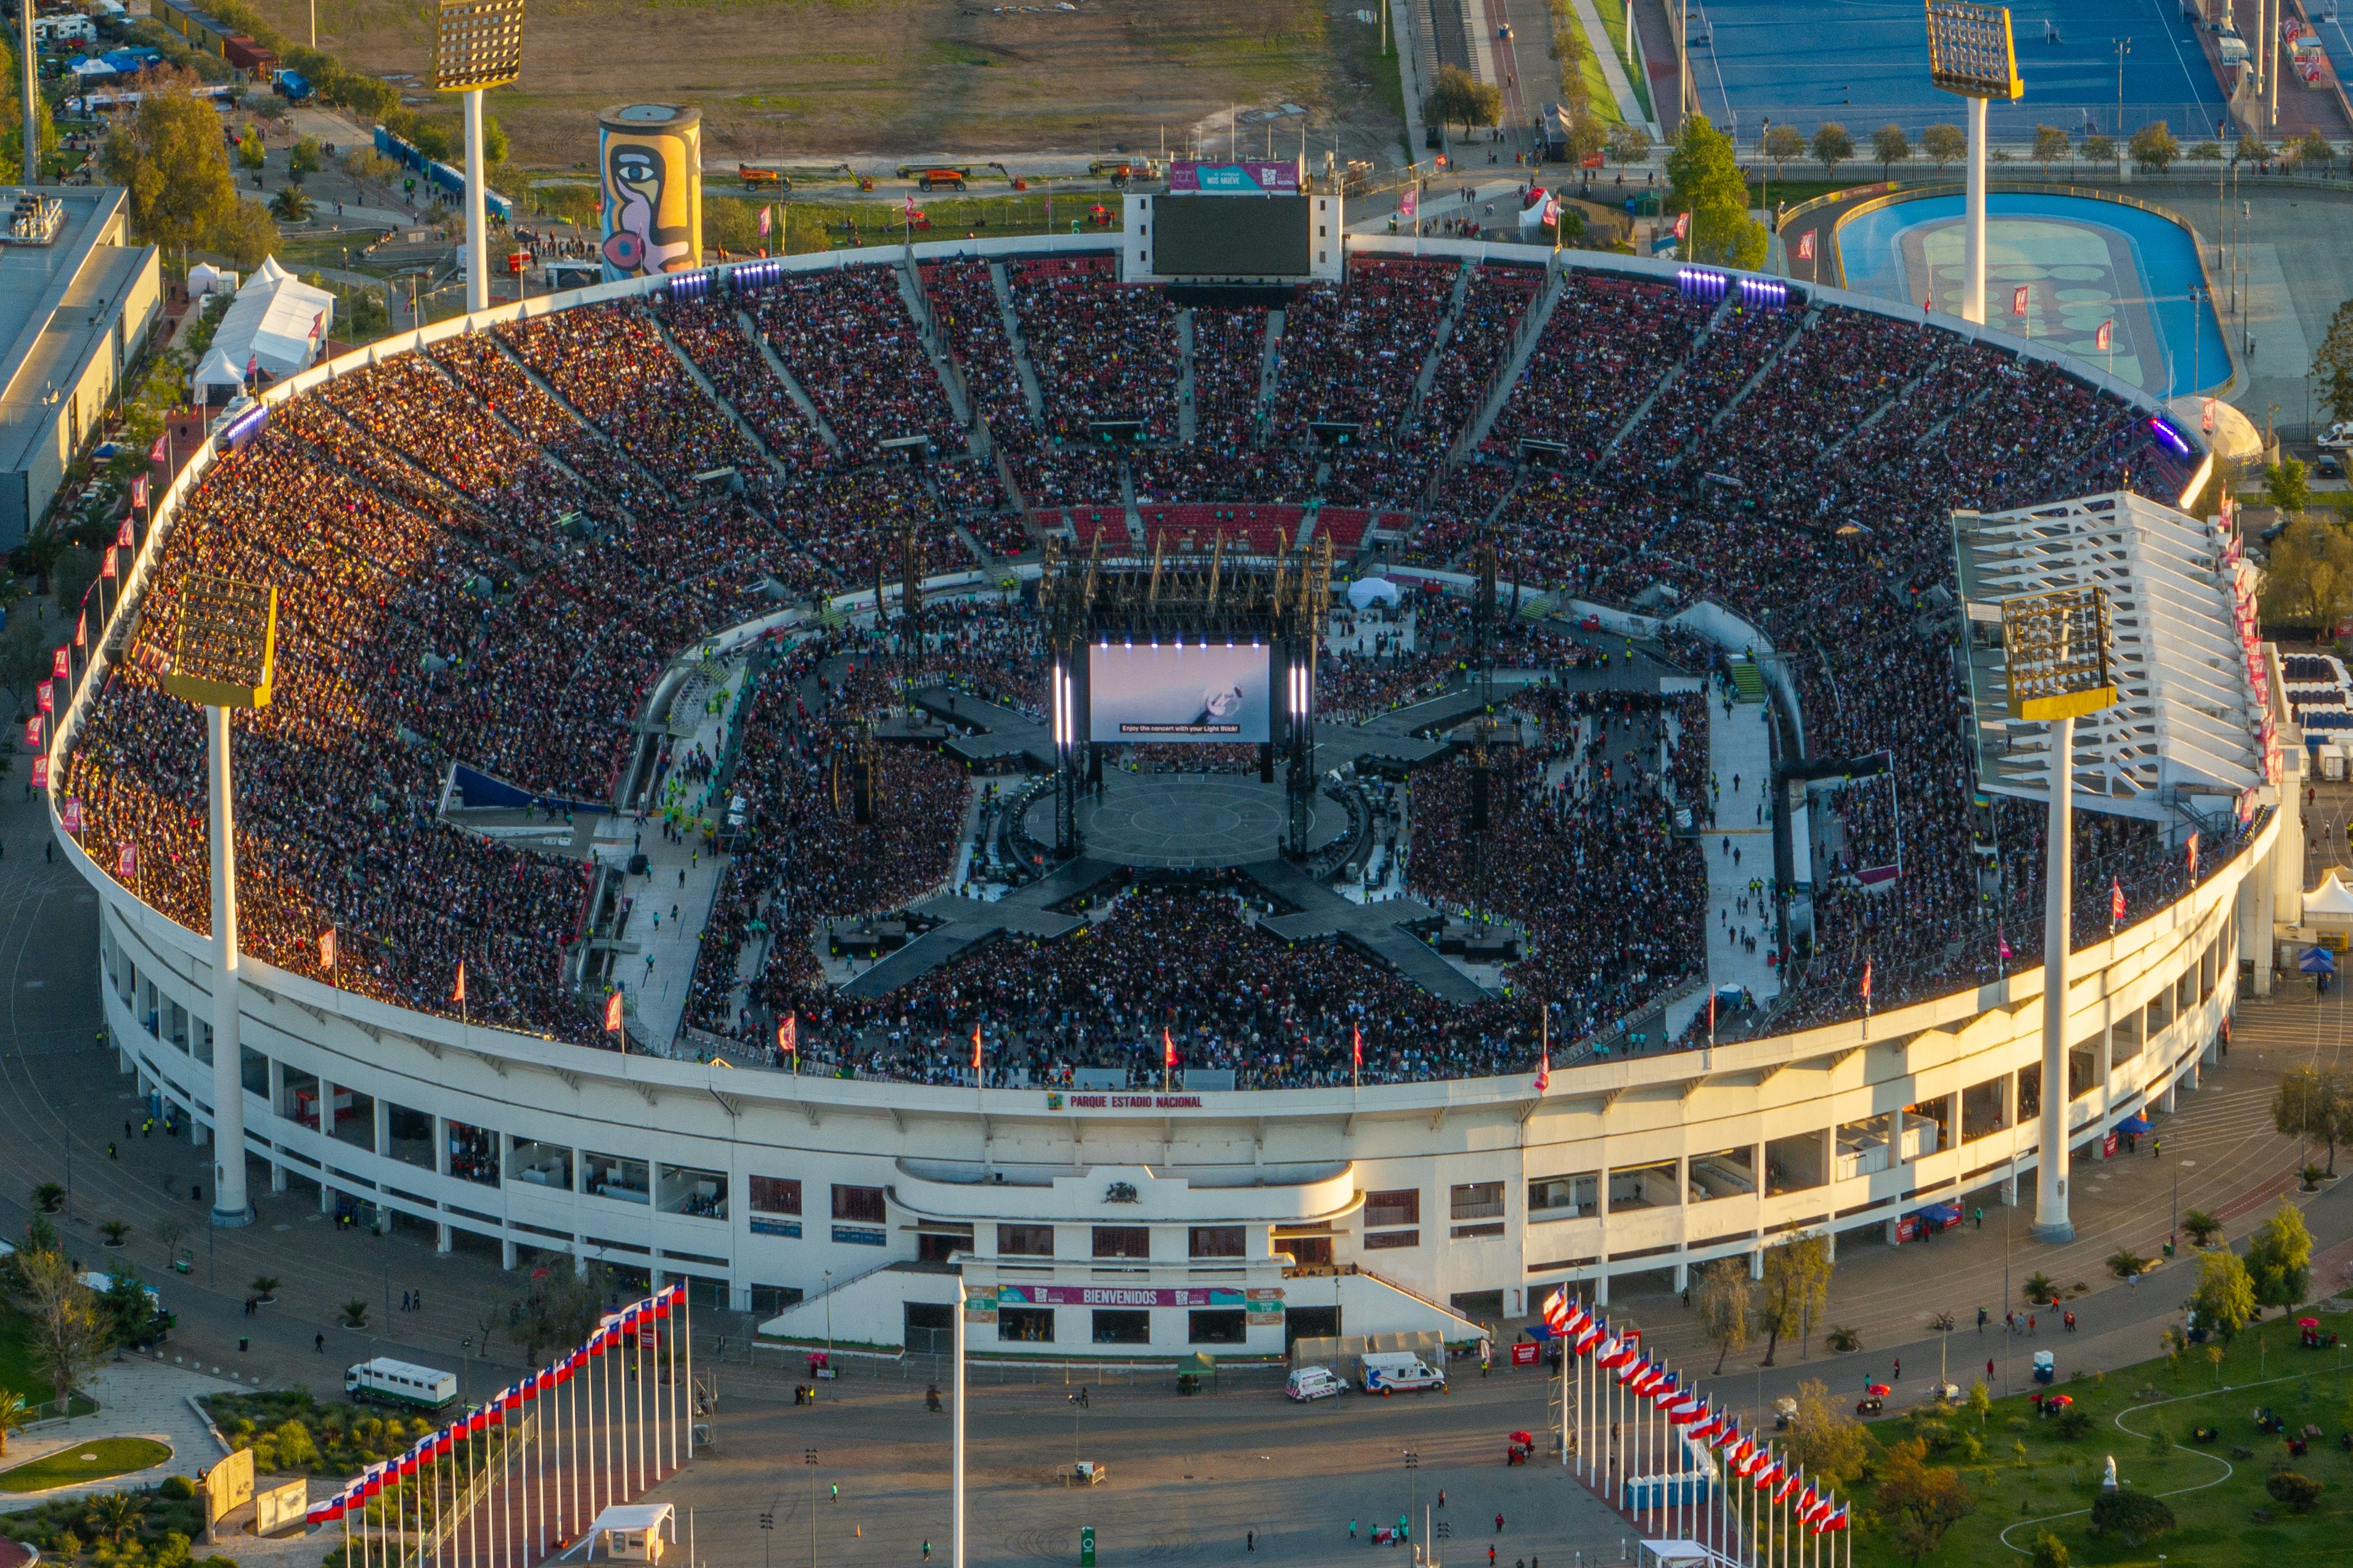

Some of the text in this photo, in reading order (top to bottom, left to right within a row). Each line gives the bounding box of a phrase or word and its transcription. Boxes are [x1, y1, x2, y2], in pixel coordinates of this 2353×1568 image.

[1070, 1095, 1202, 1108] PARQUE ESTADIO NACIONAL
[1083, 1289, 1157, 1305] BIENVENIDOS
